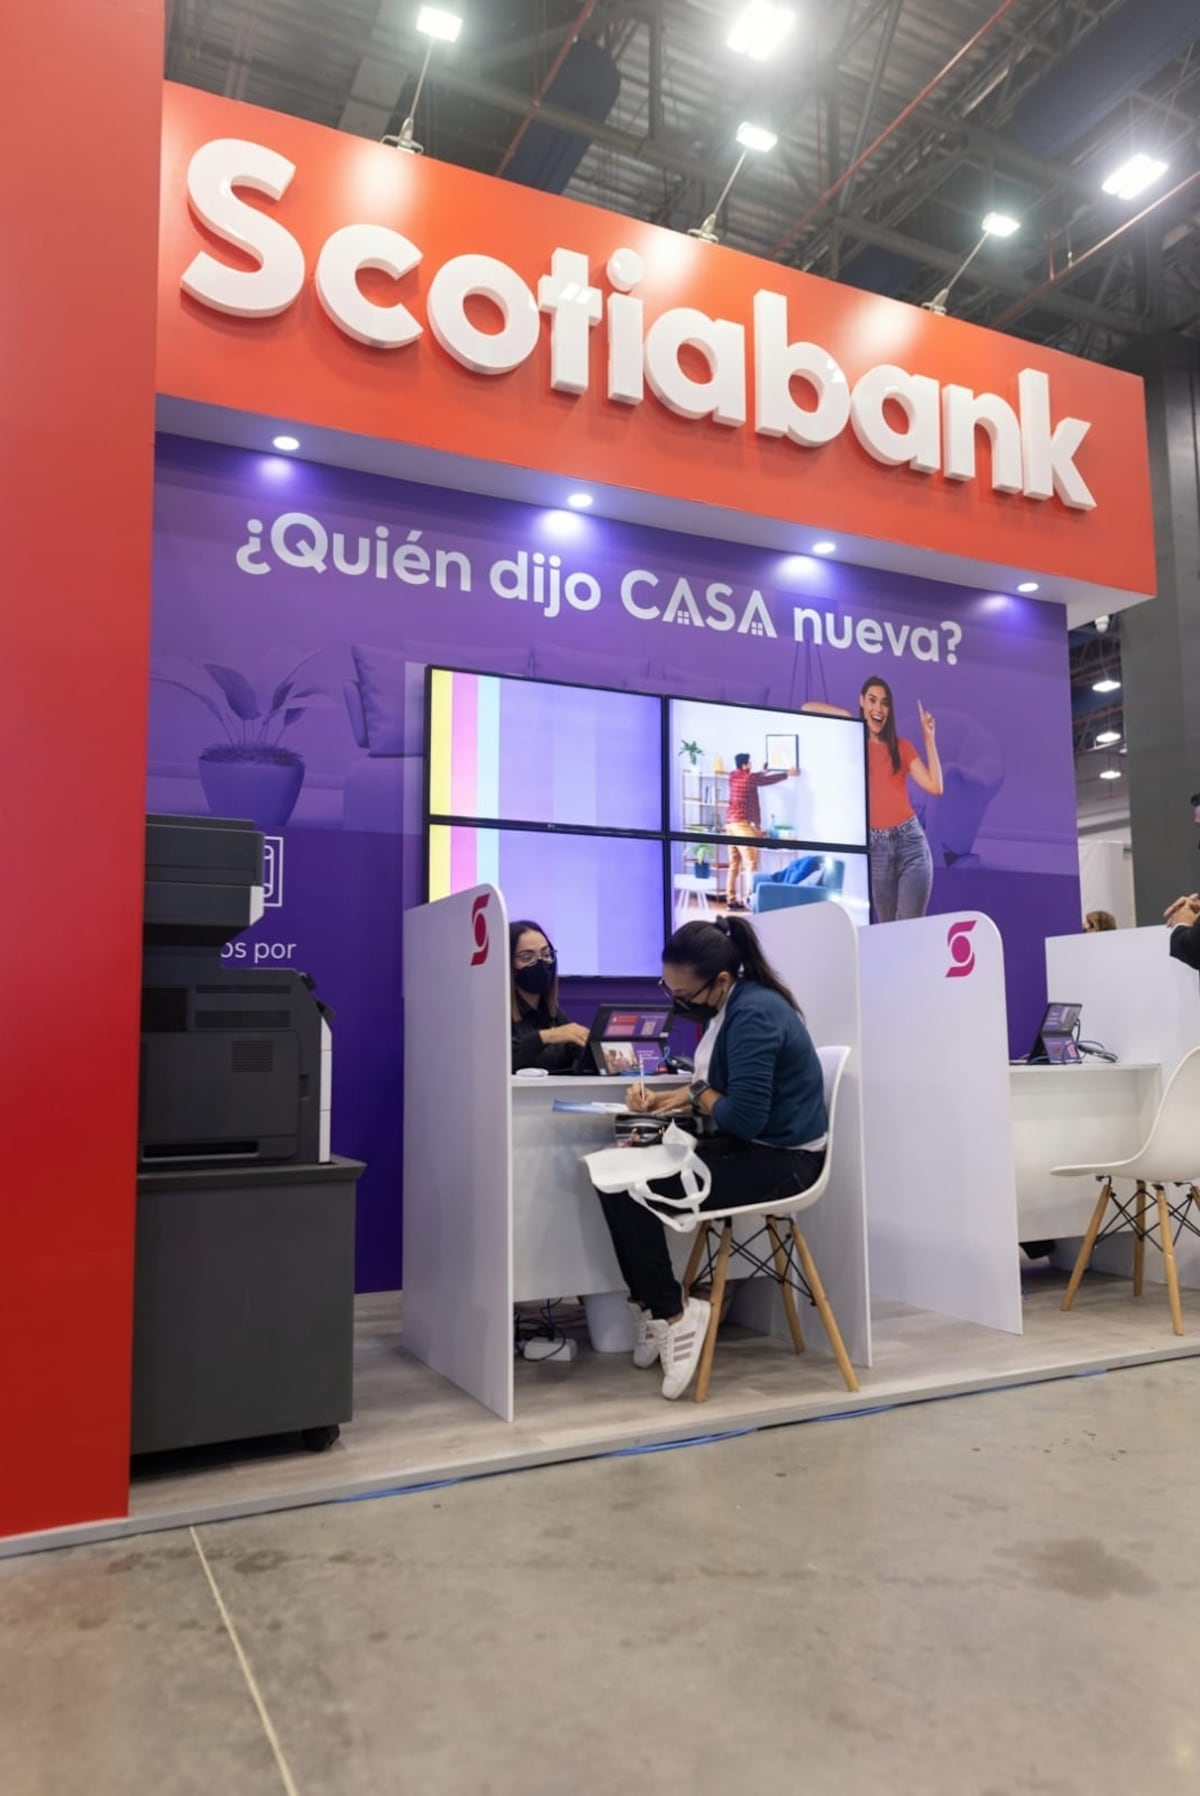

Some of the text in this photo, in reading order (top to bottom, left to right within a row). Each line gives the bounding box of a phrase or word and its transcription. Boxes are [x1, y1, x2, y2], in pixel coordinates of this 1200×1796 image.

[180, 138, 1097, 511] Scotiabank
[236, 512, 963, 666] ¿Quién dijo CASA nueva?
[254, 943, 297, 964] por
